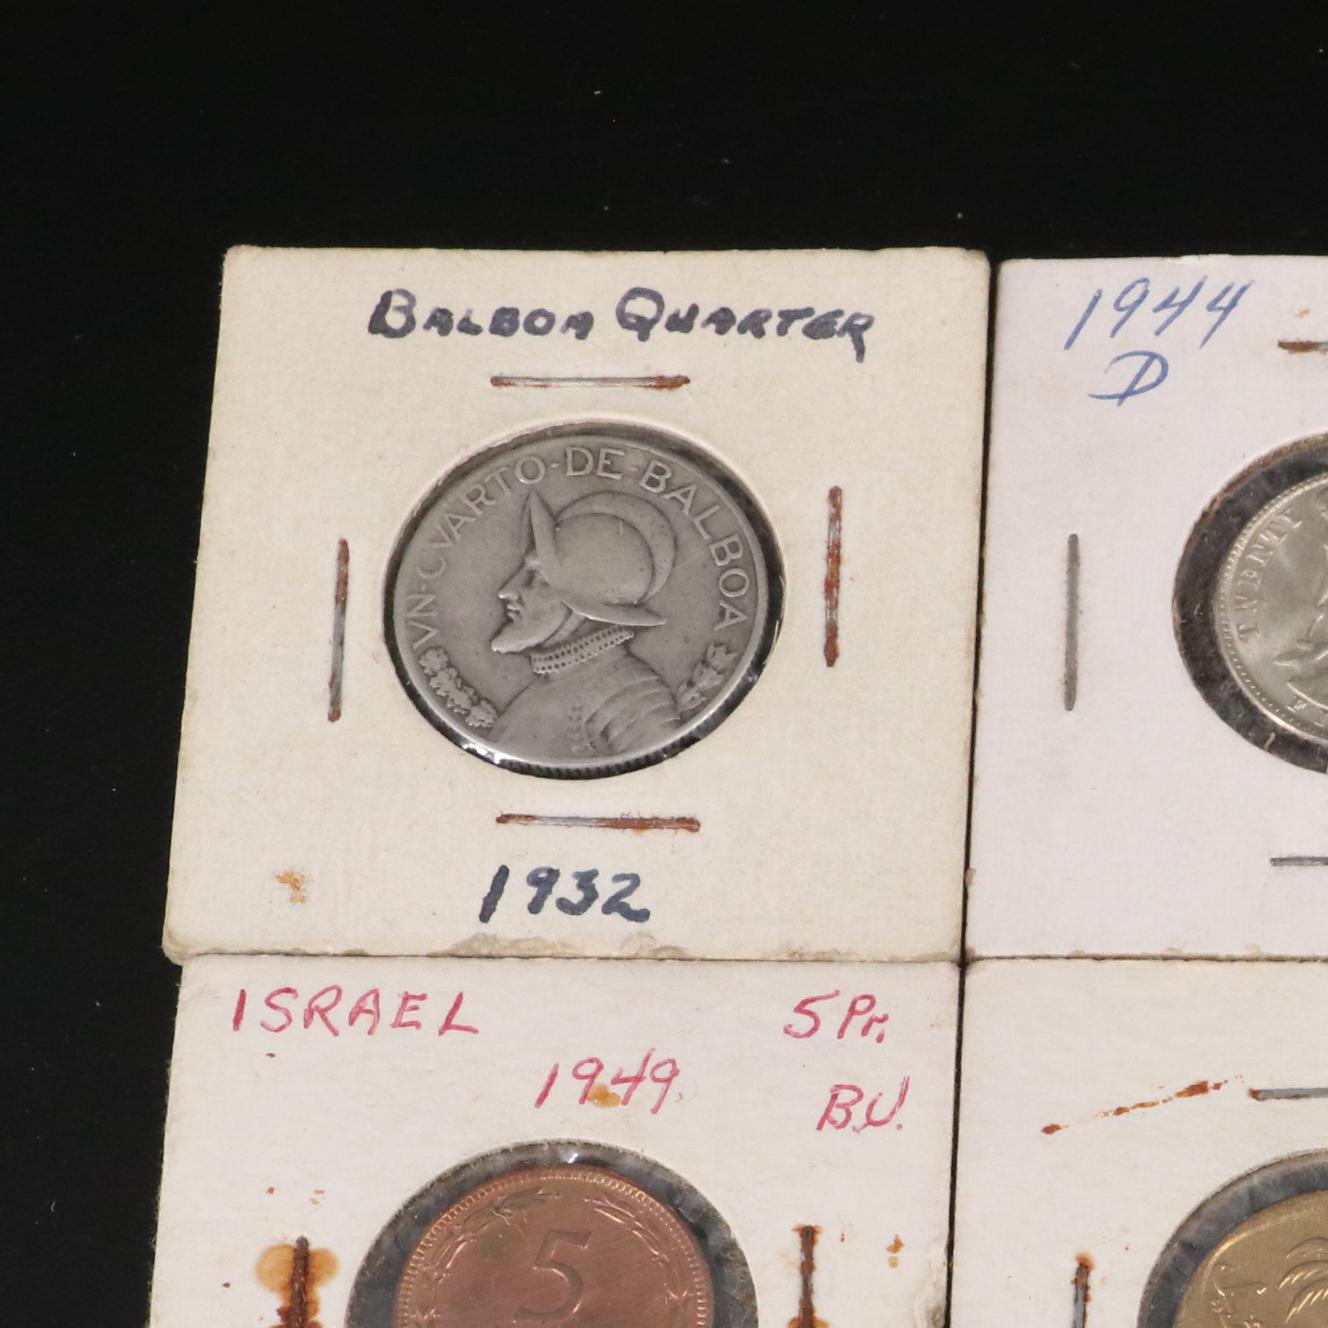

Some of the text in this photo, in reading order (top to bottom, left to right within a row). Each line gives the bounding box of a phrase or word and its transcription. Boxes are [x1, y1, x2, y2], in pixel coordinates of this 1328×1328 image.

[1063, 276, 1255, 351] 1944
[1087, 350, 1170, 407] D
[639, 460, 750, 632] BALBOA
[478, 864, 651, 924] 1932
[232, 985, 479, 1036] ISRAEL
[535, 1048, 681, 1115] 1949
[514, 1228, 592, 1322] 5
